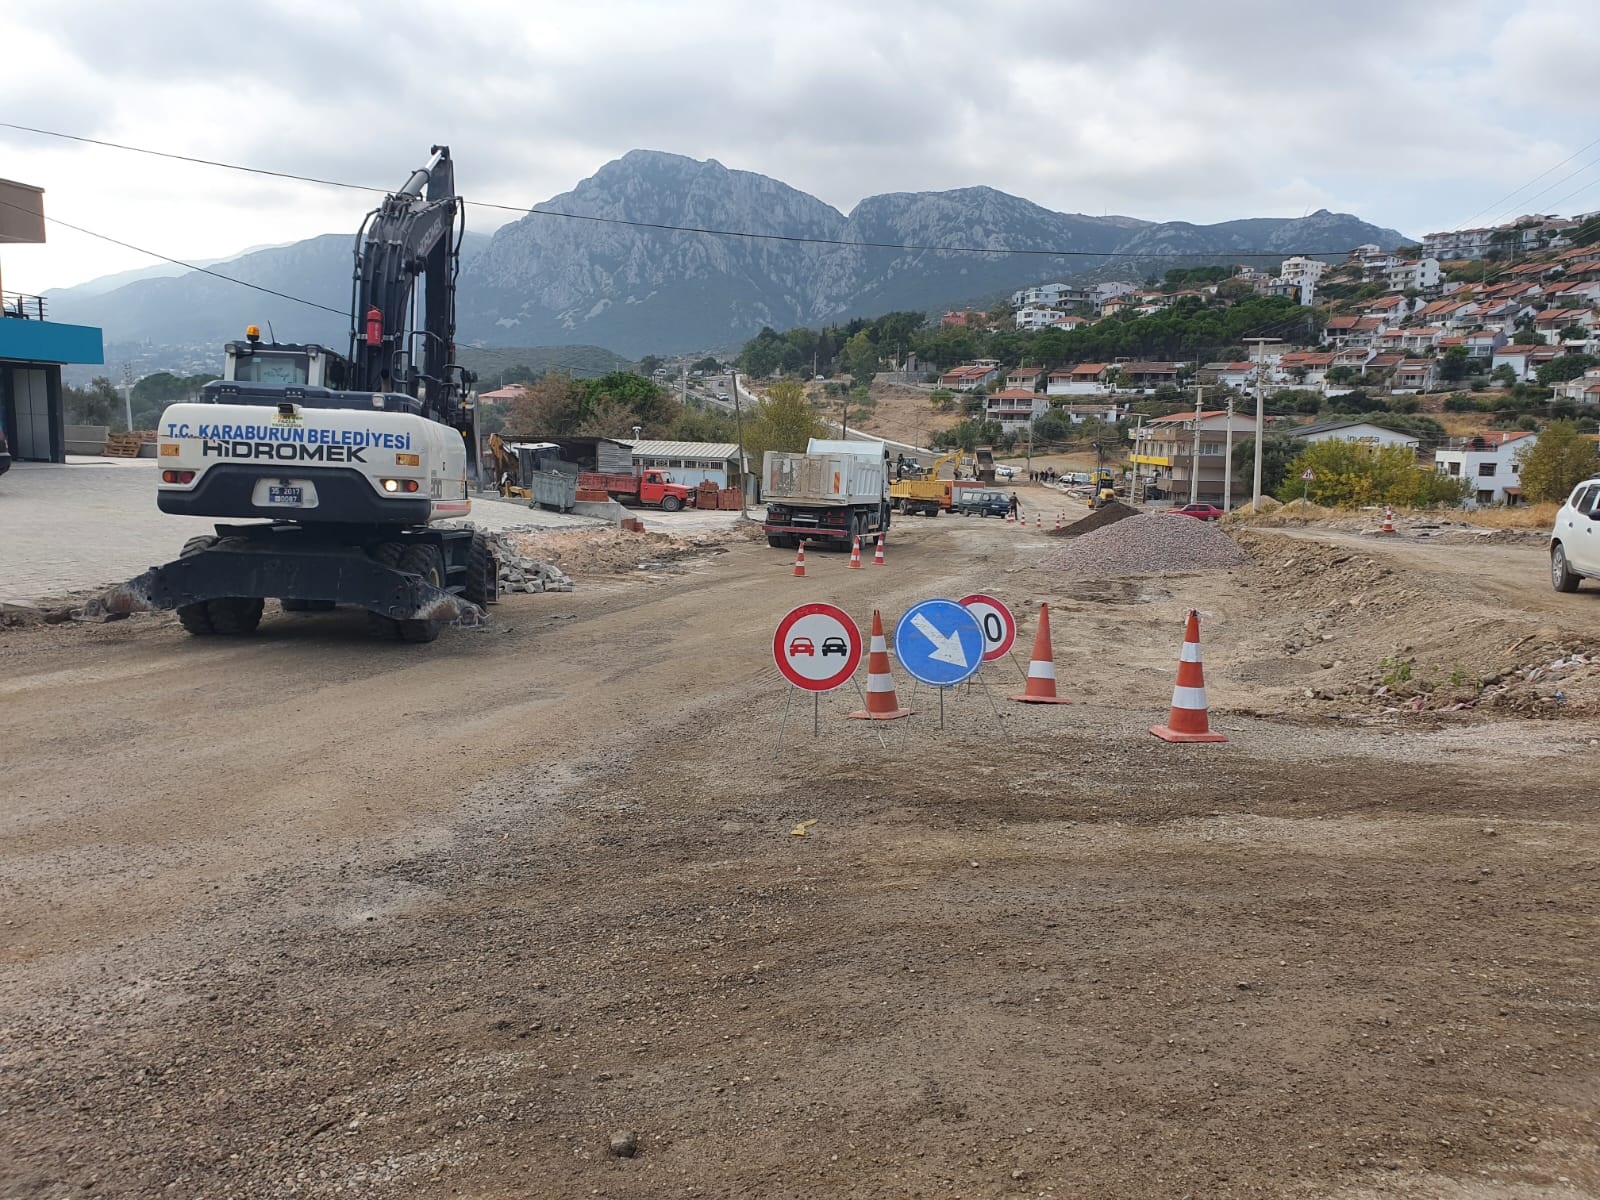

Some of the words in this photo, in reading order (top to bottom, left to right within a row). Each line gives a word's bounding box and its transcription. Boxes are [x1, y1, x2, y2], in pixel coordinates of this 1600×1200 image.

[168, 423, 194, 439] T.C.
[198, 424, 305, 442] KARABURUN
[307, 428, 411, 450] BELEDİYESİ
[983, 612, 1002, 642] 0
